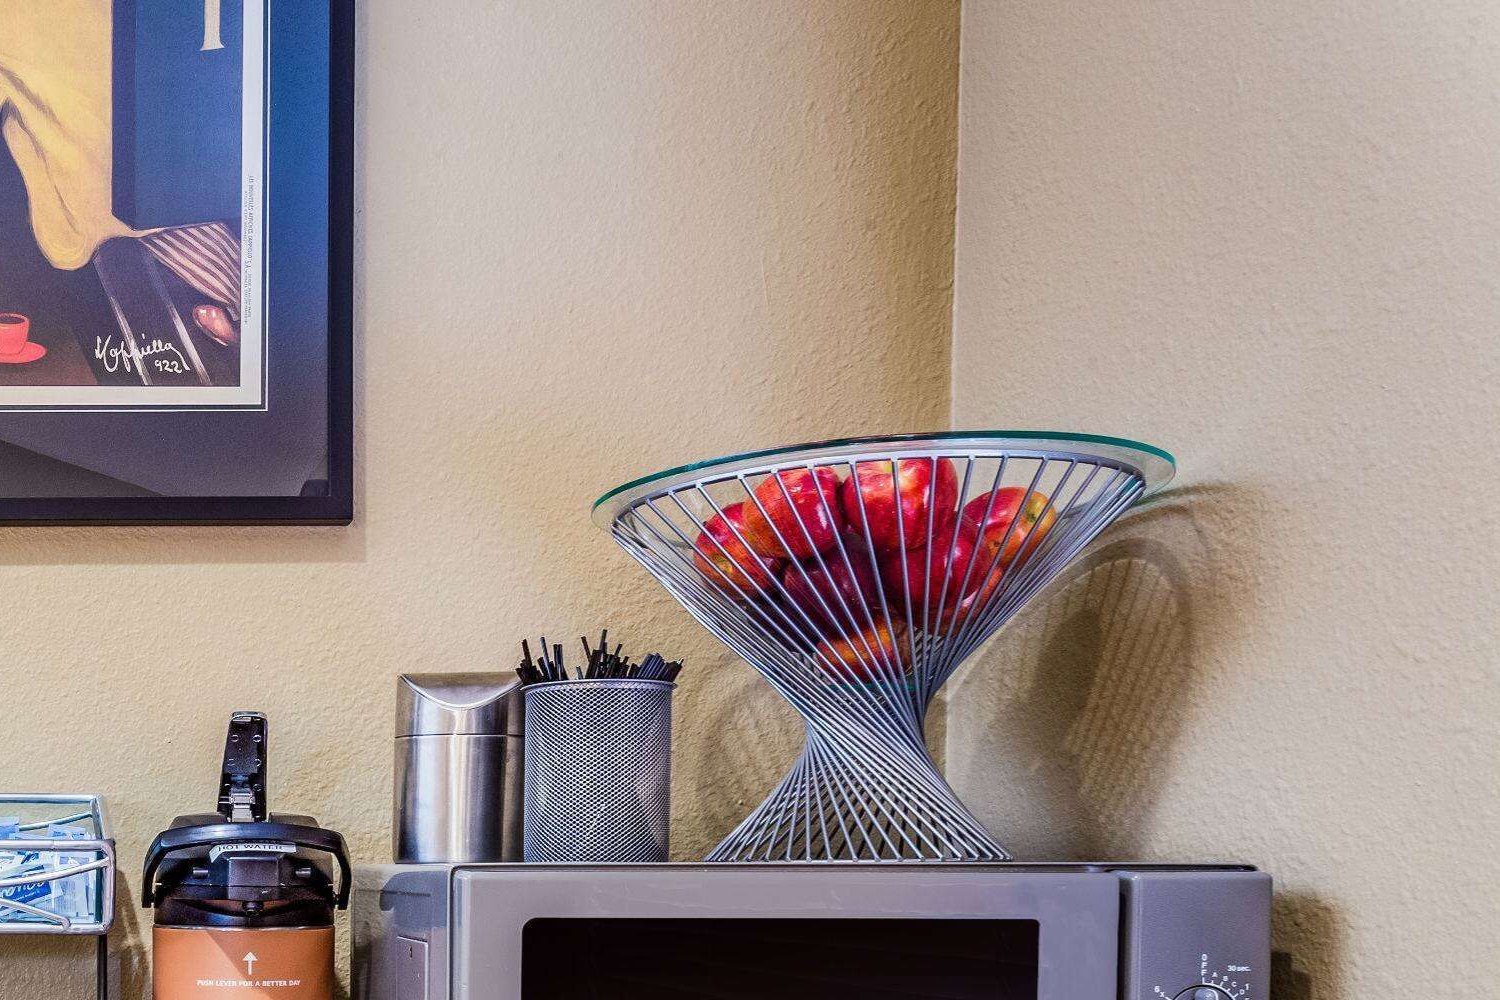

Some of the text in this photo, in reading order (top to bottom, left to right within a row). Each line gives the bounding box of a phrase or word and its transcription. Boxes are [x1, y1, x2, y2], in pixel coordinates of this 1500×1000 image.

[196, 979, 214, 987] PUSH
[215, 979, 238, 987] LEVER
[238, 979, 254, 987] FOR
[254, 979, 261, 987] A
[262, 979, 288, 987] BETTER
